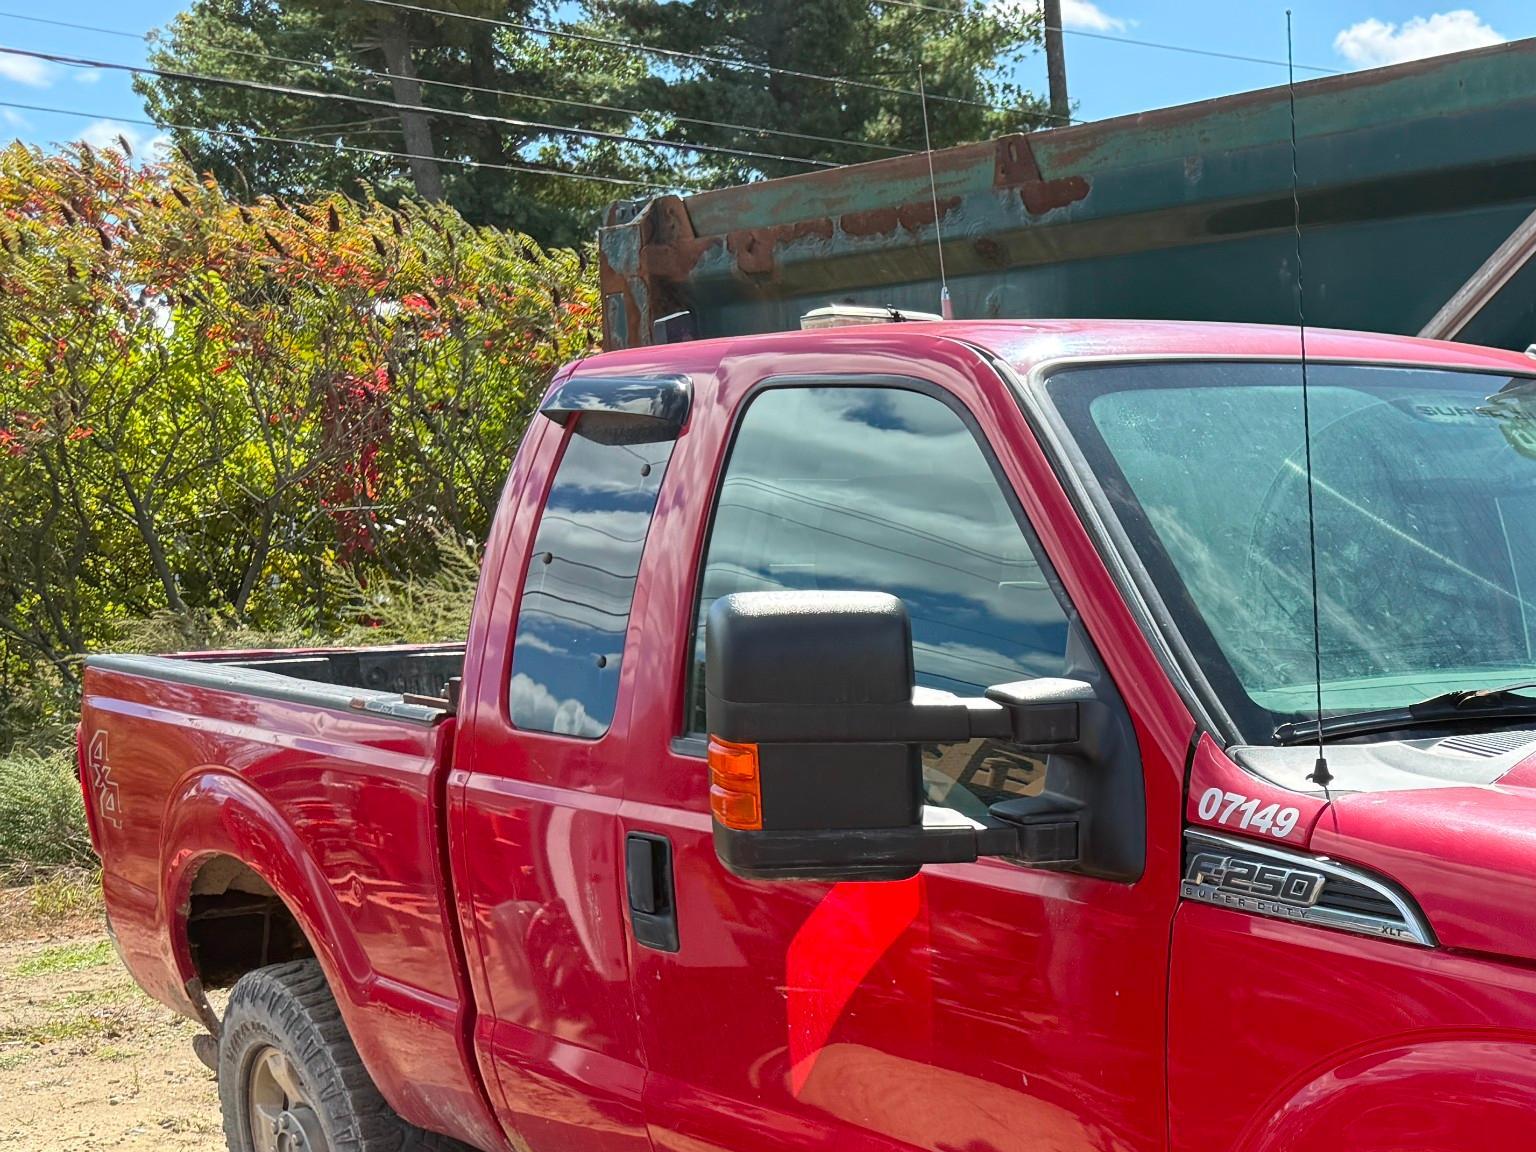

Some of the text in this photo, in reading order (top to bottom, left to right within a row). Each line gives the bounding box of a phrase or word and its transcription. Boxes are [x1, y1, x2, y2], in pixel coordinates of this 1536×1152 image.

[1198, 788, 1299, 838] 07149
[1187, 853, 1325, 908] F-250
[1185, 887, 1308, 918] SUPER DUTY
[1381, 925, 1404, 936] XLT
